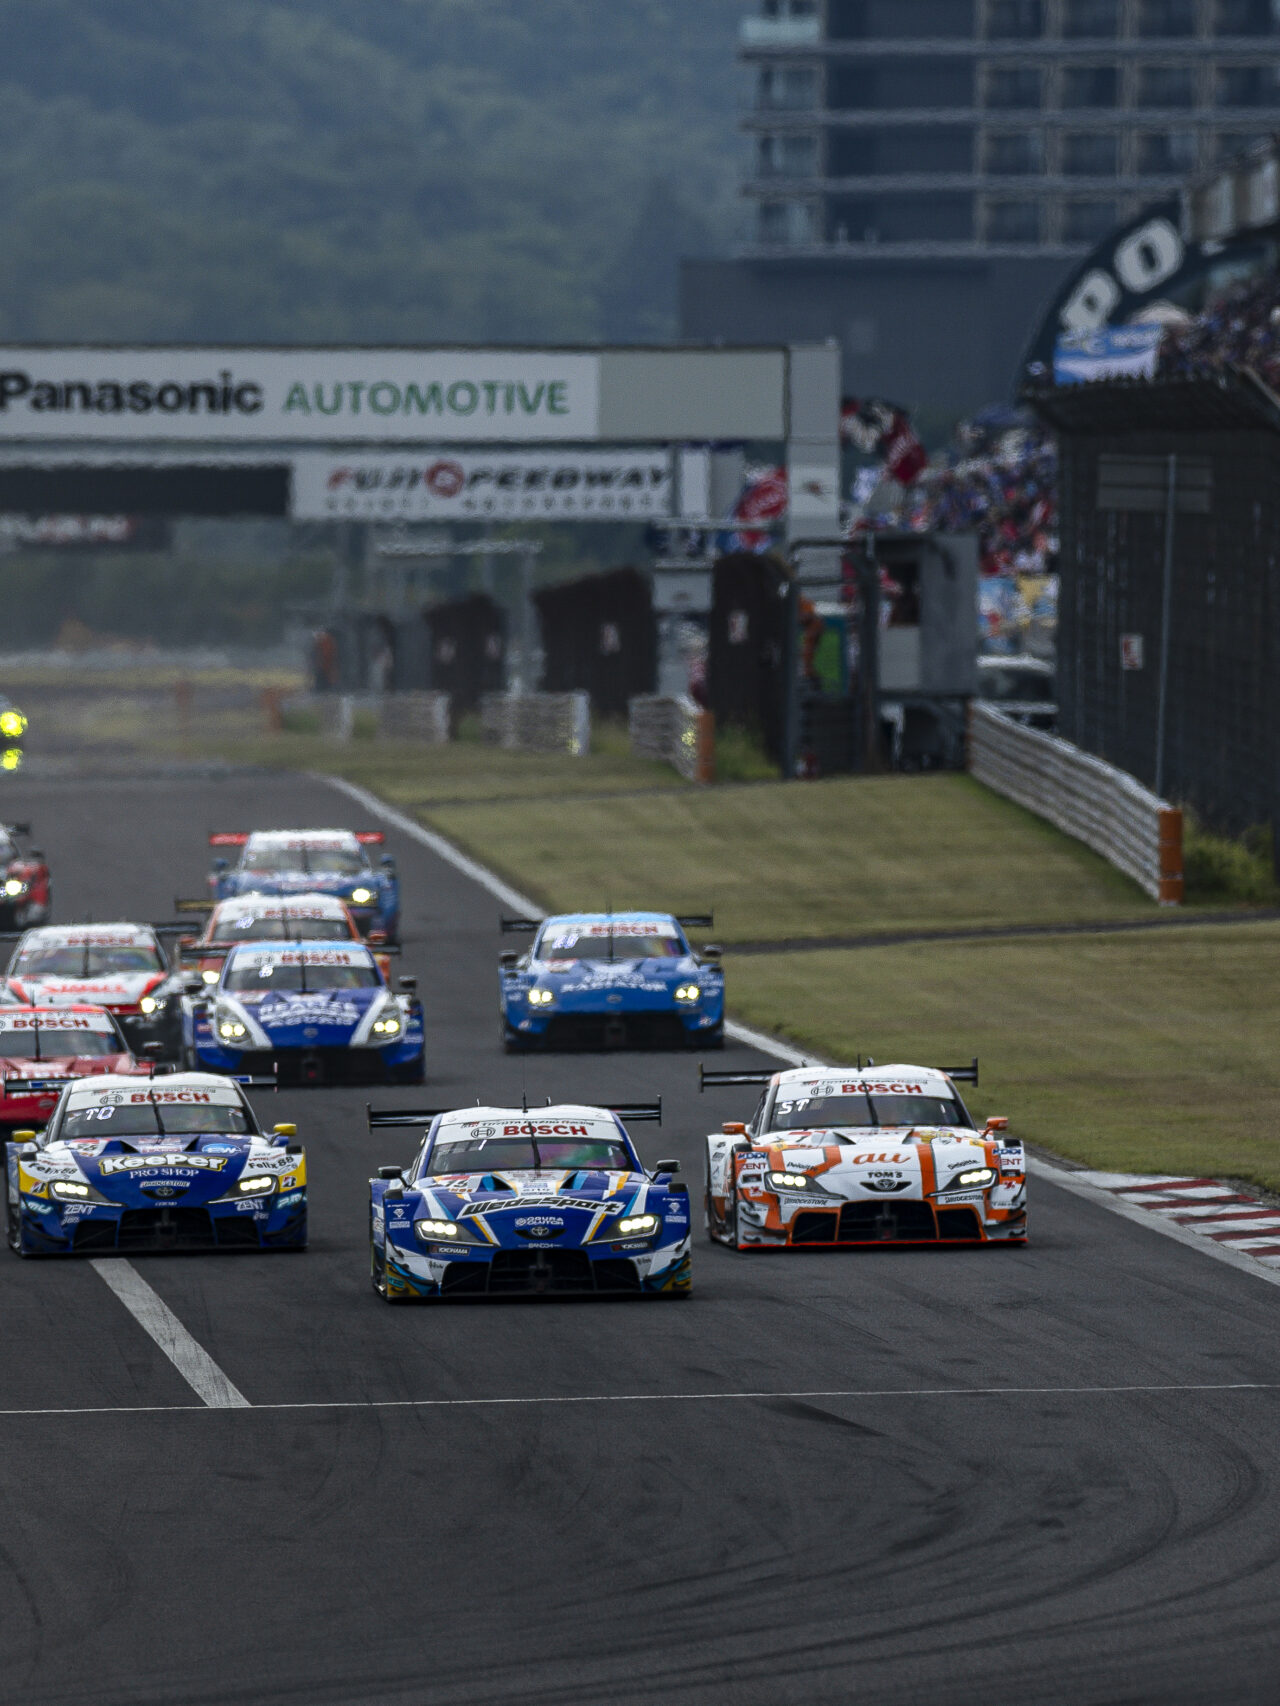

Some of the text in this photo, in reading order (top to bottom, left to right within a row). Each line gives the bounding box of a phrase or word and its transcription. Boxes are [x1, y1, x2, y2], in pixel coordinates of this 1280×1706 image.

[281, 379, 570, 417] AUTOMOTIVE
[280, 952, 351, 965] BOSCH
[13, 1018, 90, 1029] BOSCH
[841, 1083, 923, 1093] BOSCH
[130, 1092, 211, 1104] BOSCH
[503, 1125, 588, 1136] BOSCH
[737, 1152, 767, 1160] KDDI
[852, 1152, 911, 1165] au
[28, 1162, 78, 1175] Felix88
[99, 1152, 228, 1176] KeePer
[248, 1156, 295, 1170] Felix88
[129, 1168, 200, 1179] PRO SHOP
[867, 1171, 903, 1179] TOM'S
[64, 1204, 97, 1216] ZENT
[234, 1199, 264, 1212] ZENT
[461, 1196, 623, 1217] WedsSport
[437, 1246, 469, 1255] YOKOHAMA
